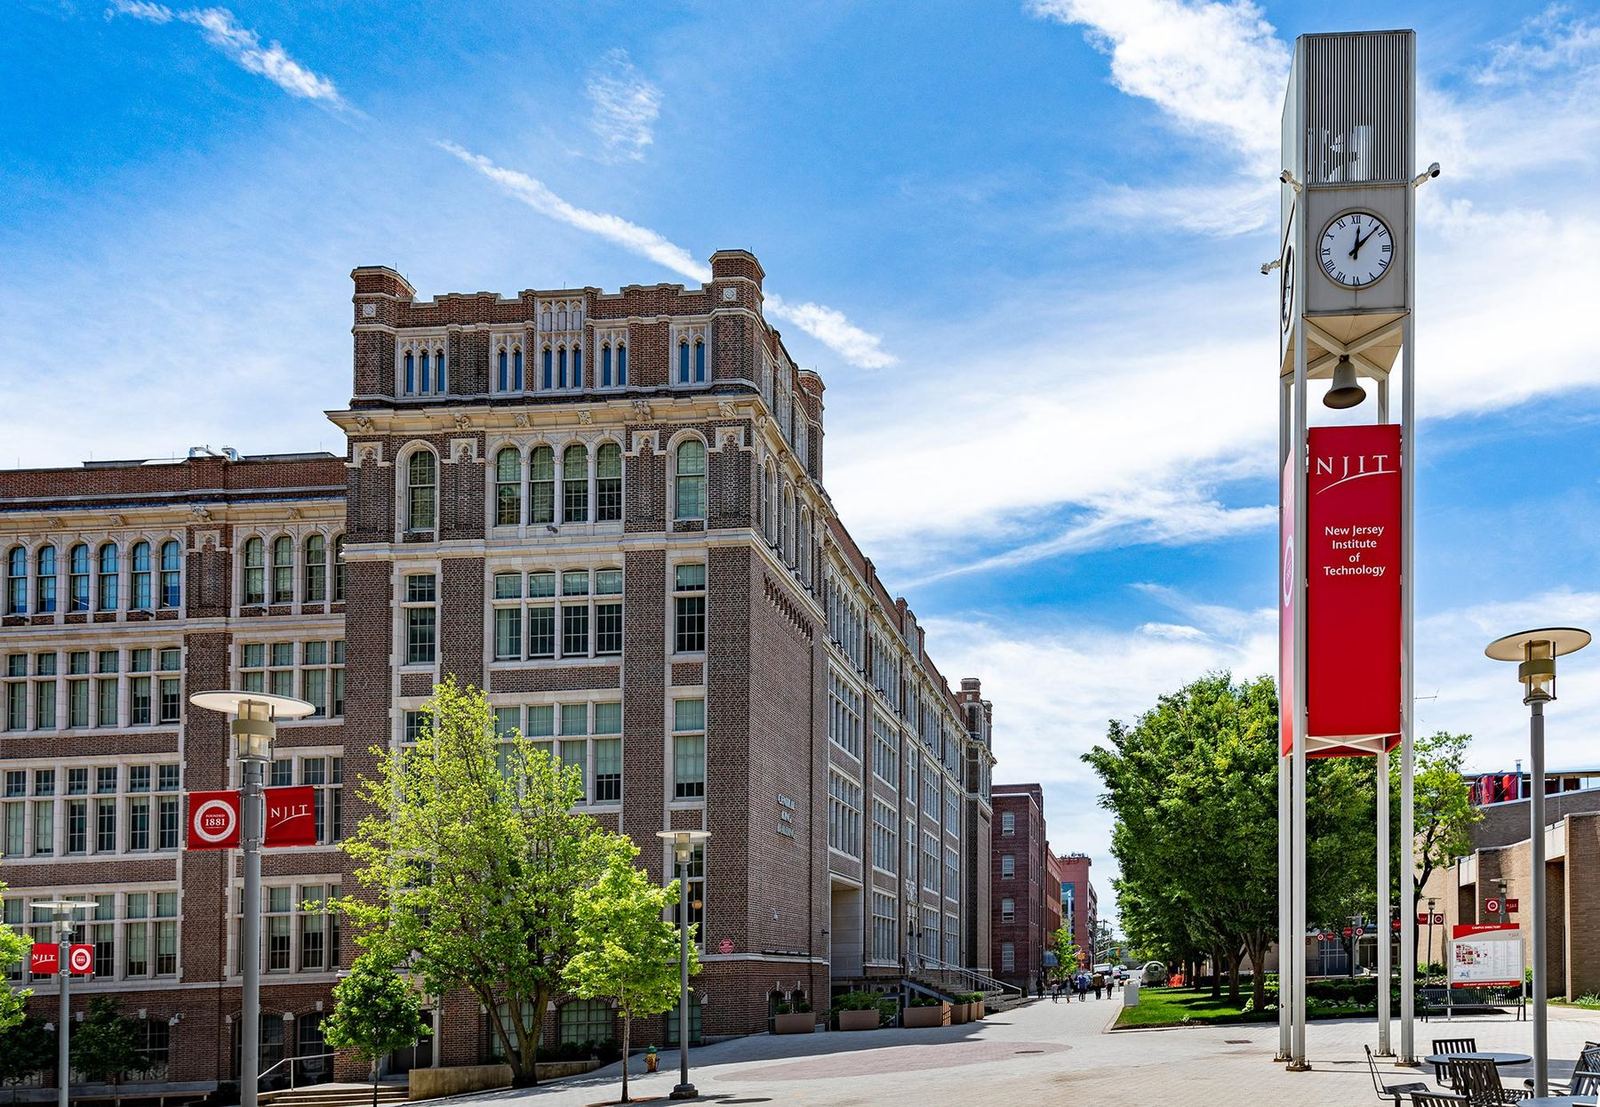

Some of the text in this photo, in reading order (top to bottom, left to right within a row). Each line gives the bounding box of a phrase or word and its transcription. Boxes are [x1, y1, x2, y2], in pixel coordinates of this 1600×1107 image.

[1316, 455, 1388, 479] NJIT
[1325, 525, 1384, 537] New Jersey
[1332, 539, 1377, 549] Institute
[1349, 552, 1360, 562] of
[1323, 565, 1386, 576] Technology
[271, 804, 308, 820] NJIT
[205, 818, 225, 826] 1881
